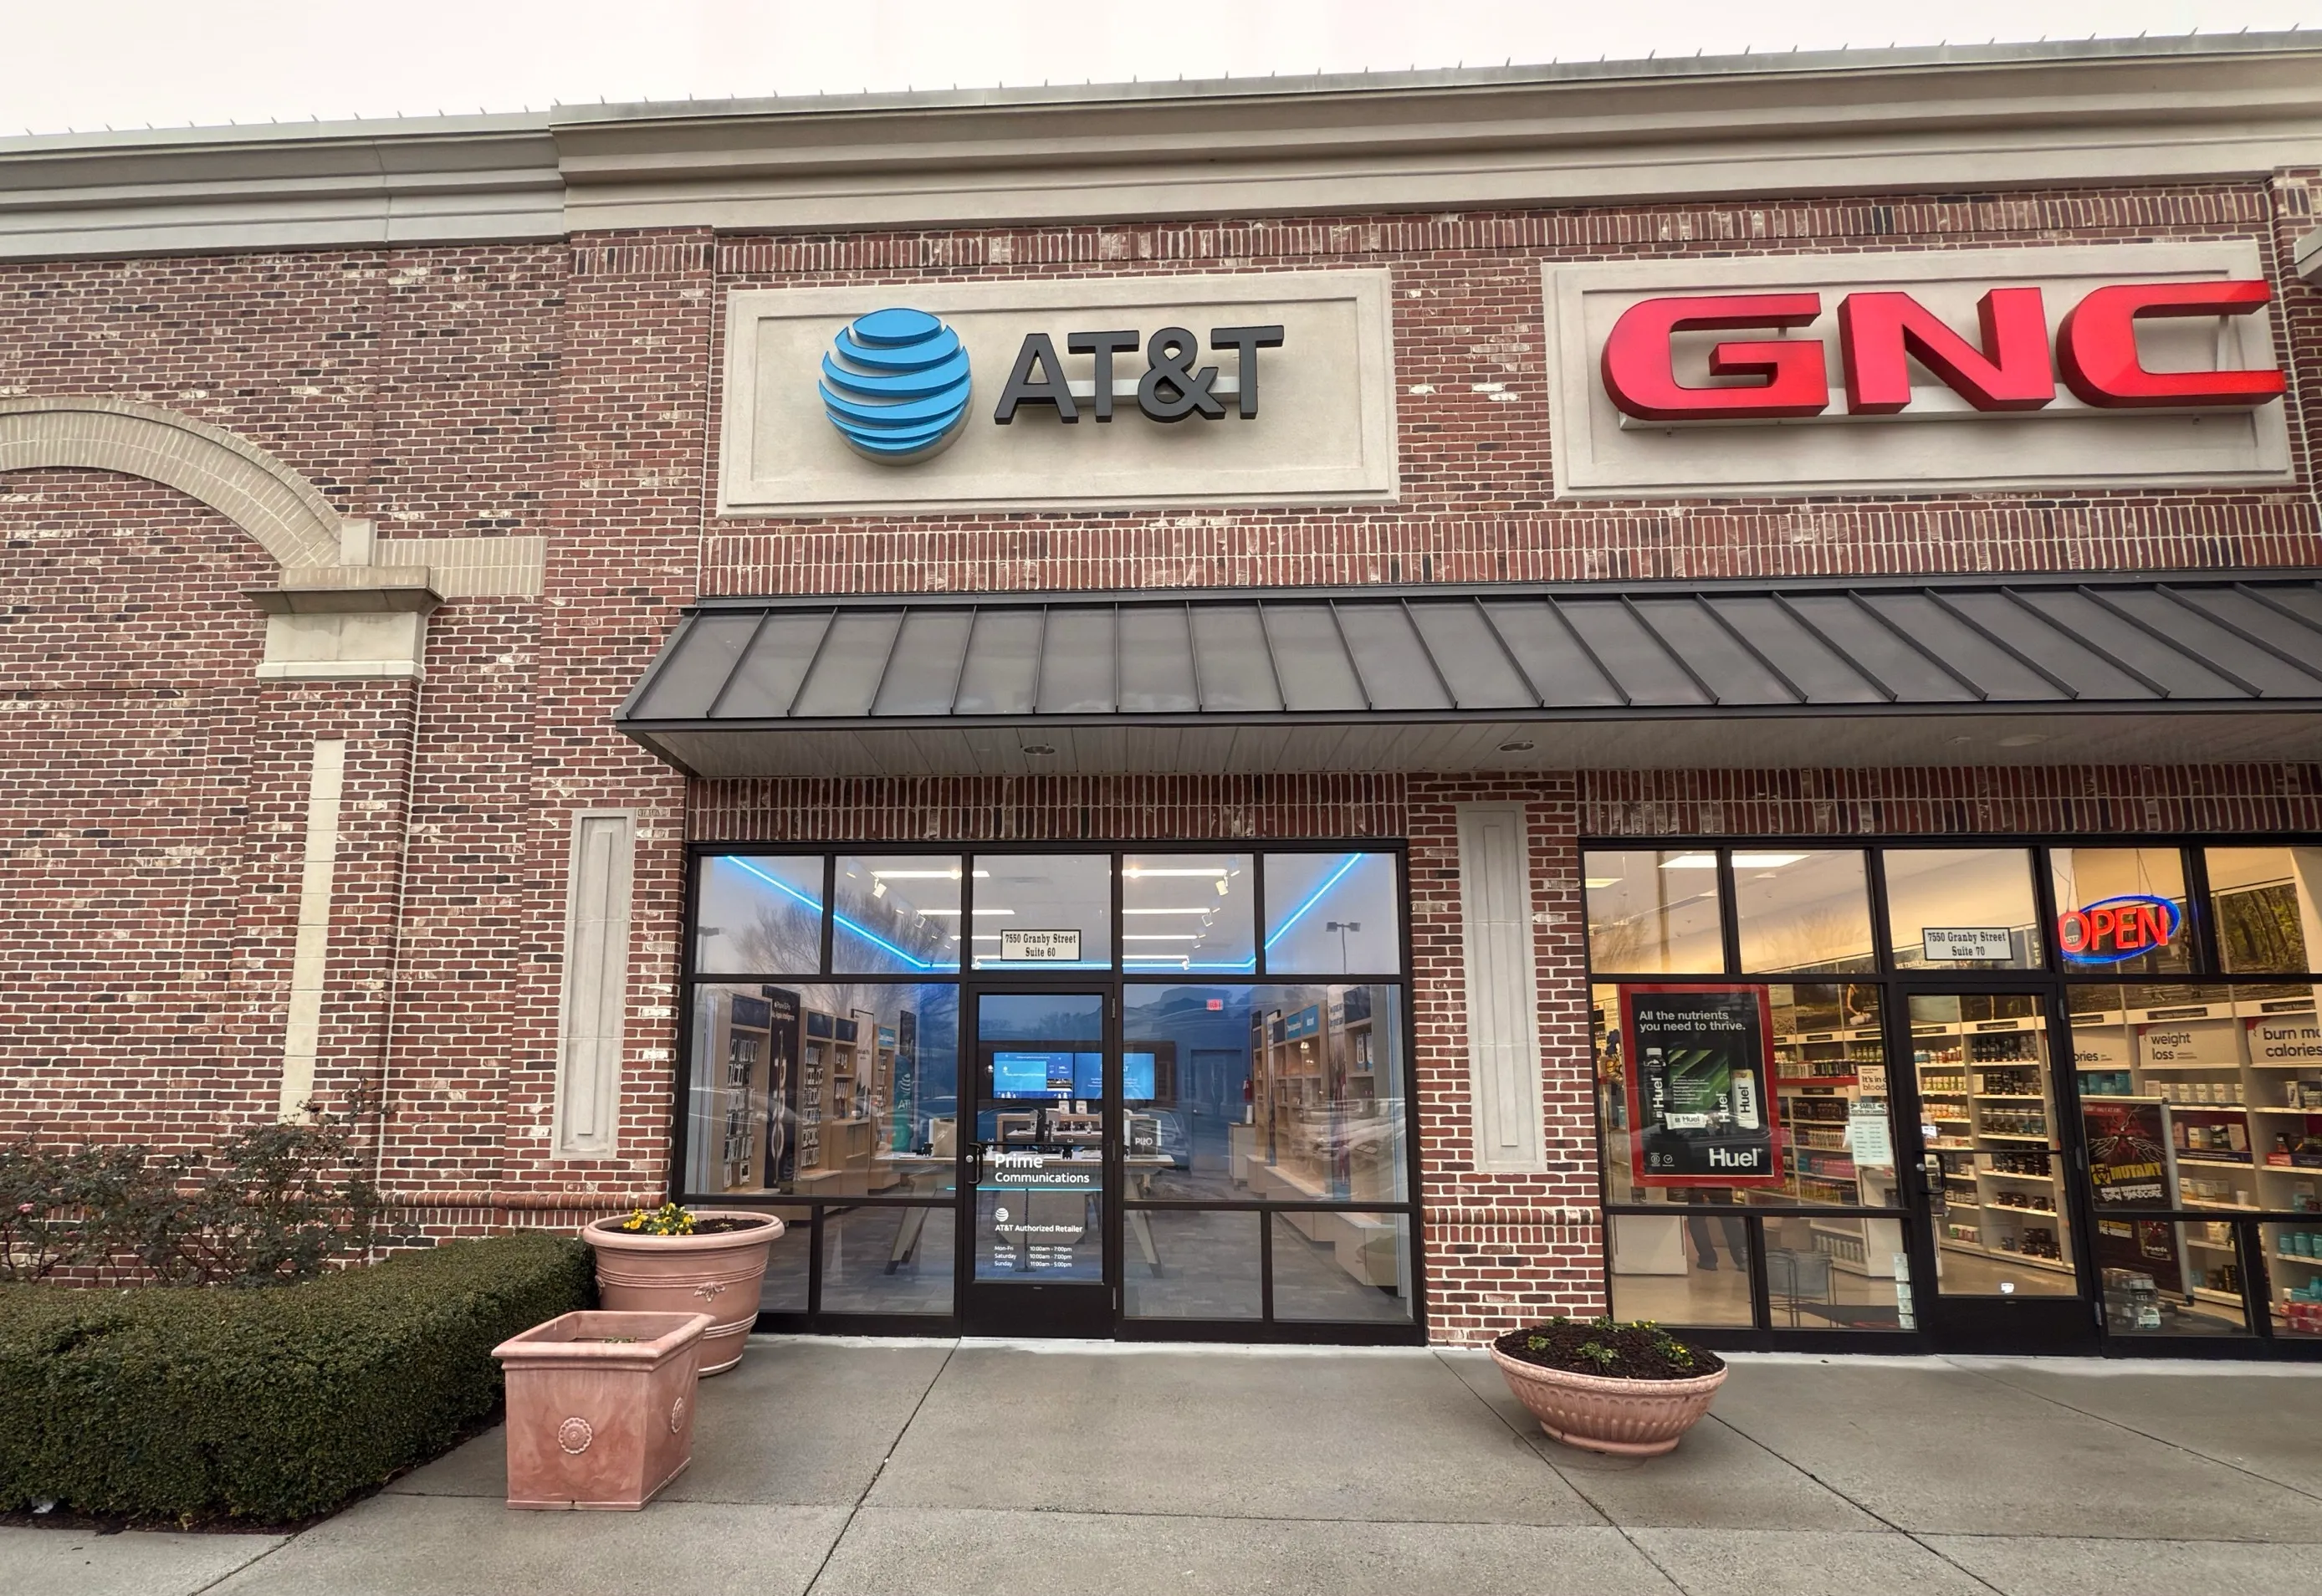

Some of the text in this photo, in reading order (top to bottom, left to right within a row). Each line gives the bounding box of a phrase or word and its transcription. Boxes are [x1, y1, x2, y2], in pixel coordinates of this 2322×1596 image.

[1601, 280, 2287, 421] GNC
[994, 325, 1284, 424] AT&T
[2059, 906, 2168, 953] OPEN
[1005, 934, 1077, 946] 7550 Granby Street
[1927, 932, 2006, 944] 7550 Granby Street
[1025, 947, 1056, 957] Suite 60
[1951, 945, 1985, 956] Suite 70
[1639, 1010, 1730, 1021] All the nutrients
[1639, 1021, 1746, 1033] you need to thrive.
[2263, 1027, 2297, 1041] burn
[2151, 1032, 2192, 1047] weight
[2152, 1047, 2175, 1060] loss
[2265, 1042, 2322, 1057] calories
[1651, 1077, 1665, 1108] Huel
[1738, 1086, 1751, 1113] Huel
[1716, 1092, 1731, 1123] Huel
[995, 1154, 1043, 1169] Prime
[1709, 1148, 1758, 1167] Huel
[995, 1172, 1090, 1183] Communications
[995, 1224, 1083, 1233] AT&T Authorized Retailer
